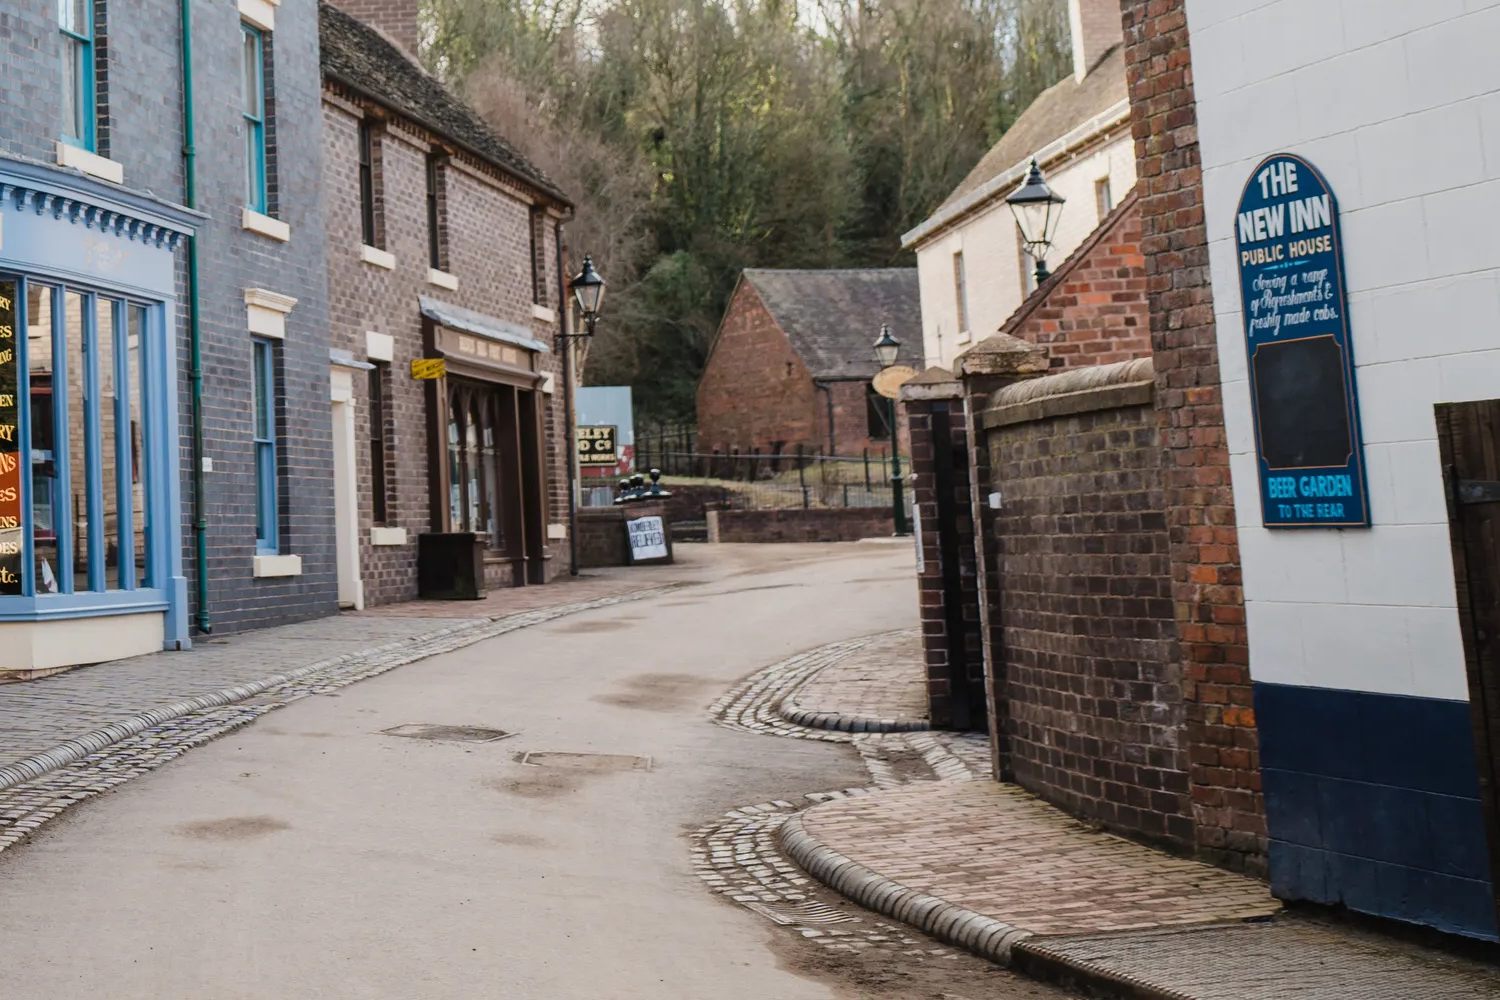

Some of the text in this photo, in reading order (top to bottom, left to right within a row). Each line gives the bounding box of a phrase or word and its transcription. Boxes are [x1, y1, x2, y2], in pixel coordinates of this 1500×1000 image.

[1258, 162, 1298, 199] THE
[1238, 194, 1331, 243] NEW INN
[1242, 235, 1332, 266] PUBLIC HOUSE
[1252, 269, 1328, 293] Serving a range
[1250, 298, 1259, 317] of
[1249, 311, 1281, 337] freshly
[1284, 307, 1310, 326] made
[578, 428, 611, 439] ELEY
[1268, 475, 1352, 498] BEER GARDEN
[1278, 503, 1345, 518] TO THE REAR
